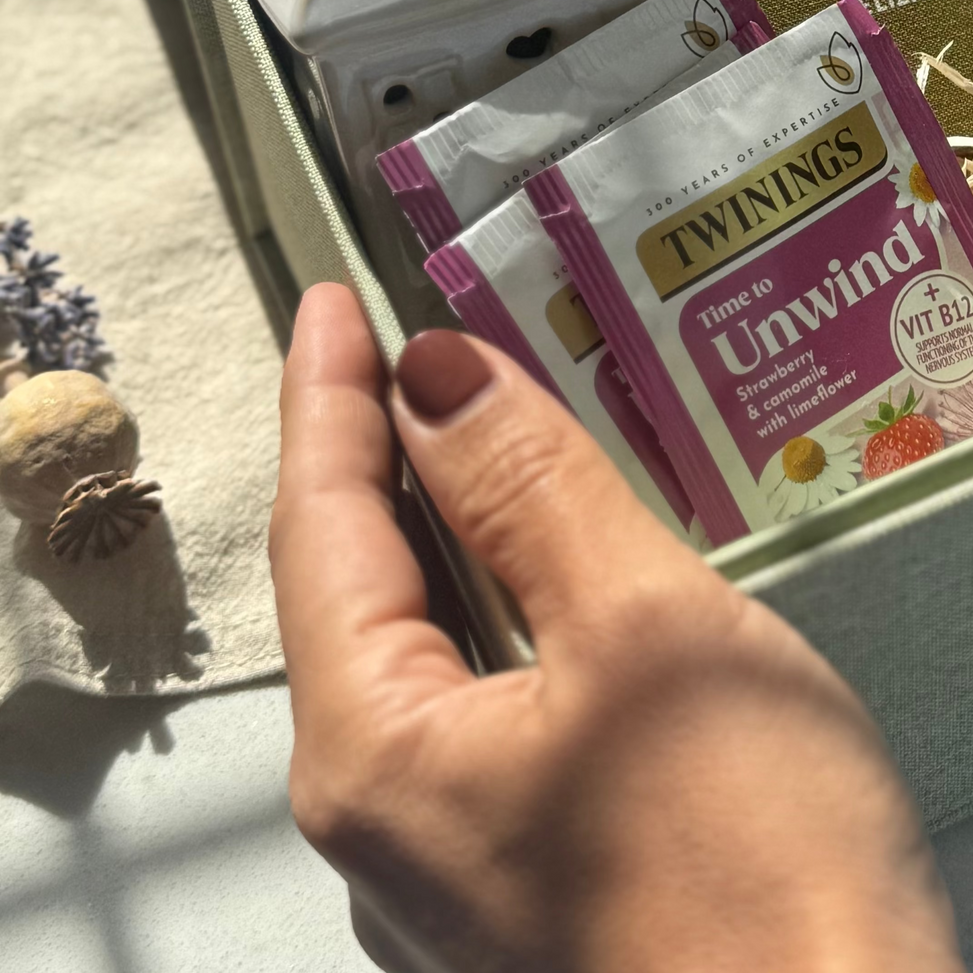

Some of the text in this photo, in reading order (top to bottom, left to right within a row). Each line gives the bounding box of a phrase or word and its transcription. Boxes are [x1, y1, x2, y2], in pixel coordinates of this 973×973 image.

[502, 169, 530, 189] 300
[539, 133, 589, 166] YEARS
[646, 98, 840, 217] 300 YEARS OF EXPERTISE
[659, 126, 863, 270] TWININGS
[697, 278, 774, 329] Time to
[710, 219, 925, 375] Unwind
[900, 309, 934, 339] VIT
[916, 332, 949, 352] SUPPORTS
[916, 340, 959, 365] FUNCTIONING
[959, 336, 967, 349] OF
[925, 354, 955, 374] NERVOUS
[736, 349, 814, 402] Strawberry
[747, 364, 828, 420] & camomile
[757, 369, 857, 438] with limeflower
